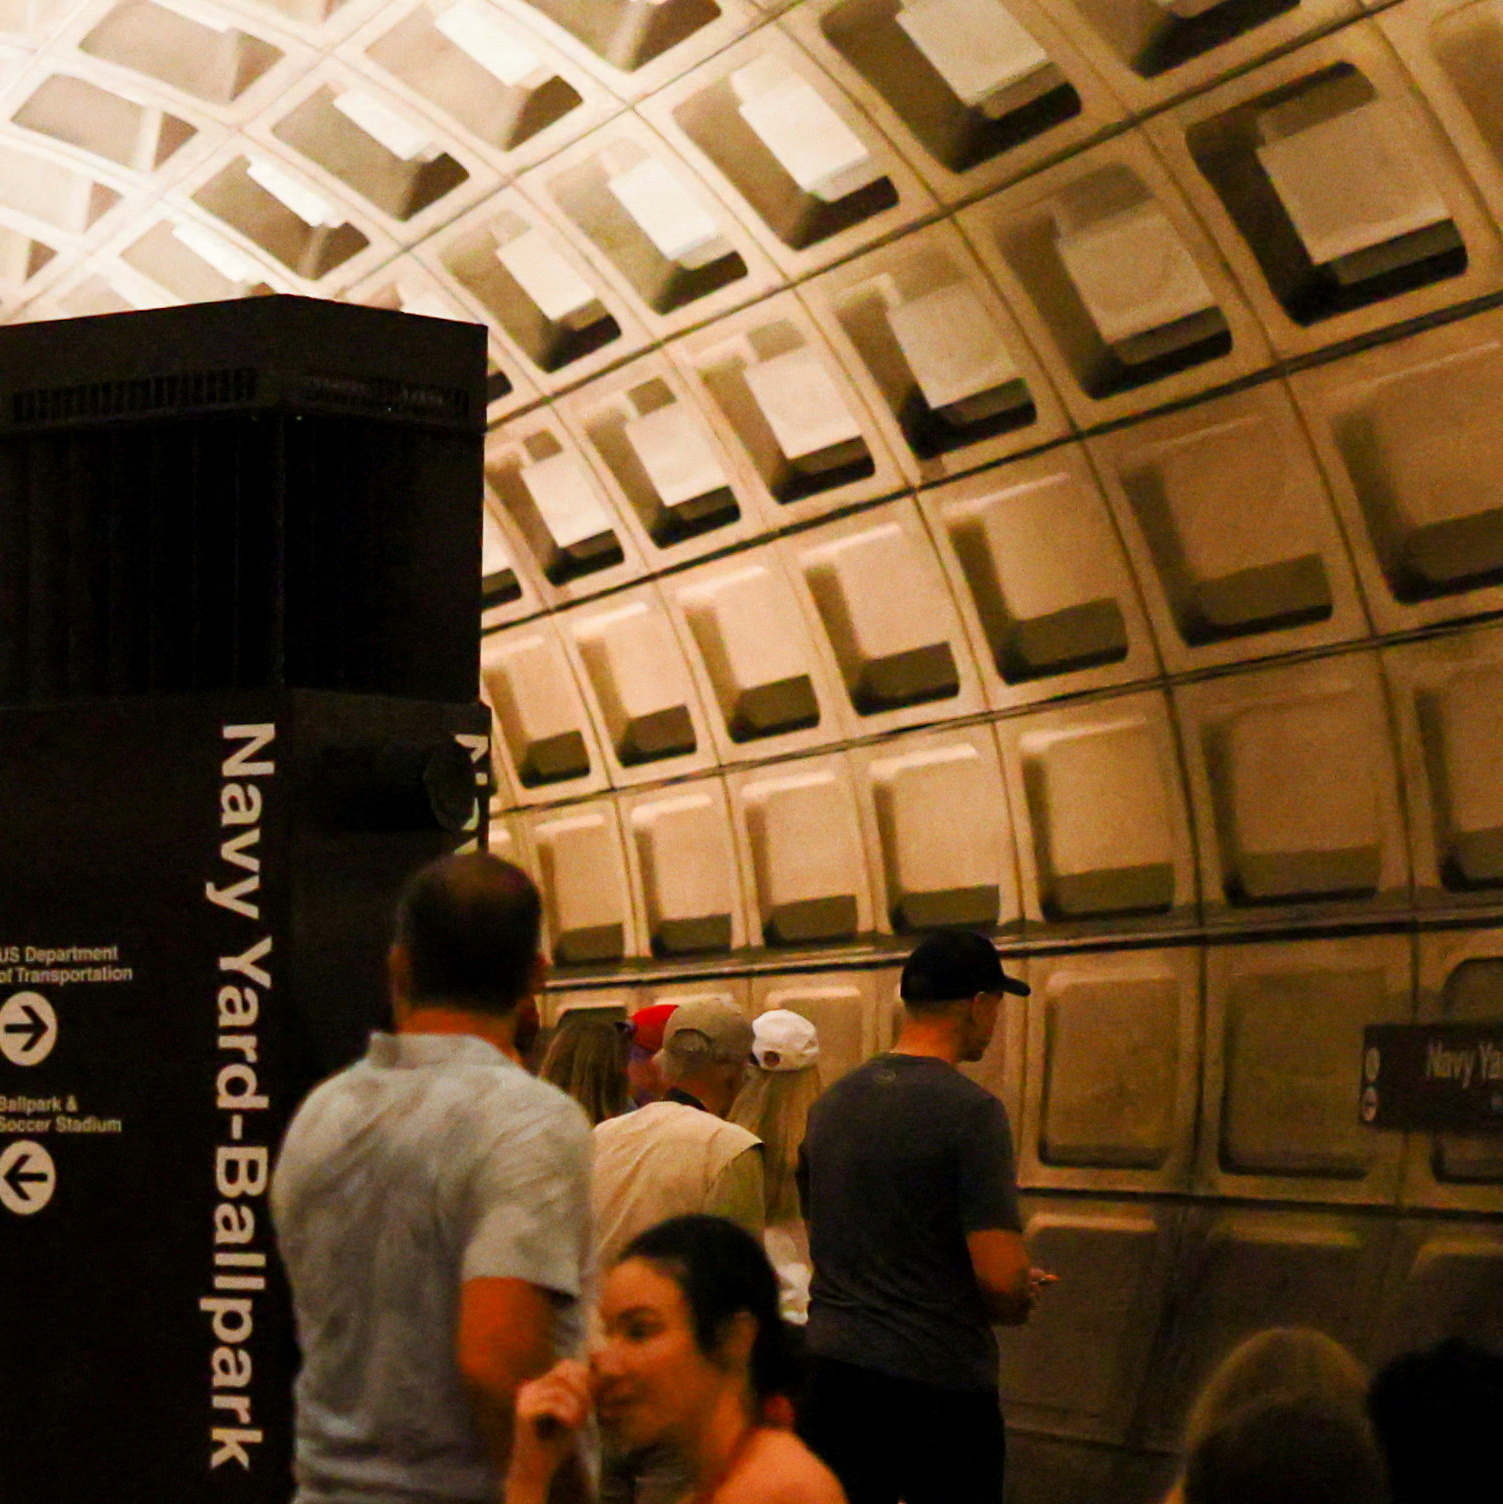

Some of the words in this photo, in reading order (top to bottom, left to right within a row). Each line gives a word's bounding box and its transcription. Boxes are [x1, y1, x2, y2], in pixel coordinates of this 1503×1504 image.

[205, 722, 276, 920] Navy
[24, 945, 120, 966] Department
[16, 966, 133, 987] Transportation
[1426, 1041, 1476, 1089] Navy
[65, 1094, 79, 1113] &
[55, 1114, 123, 1133] Stadium
[198, 934, 274, 1470] Yard-Ballpark
